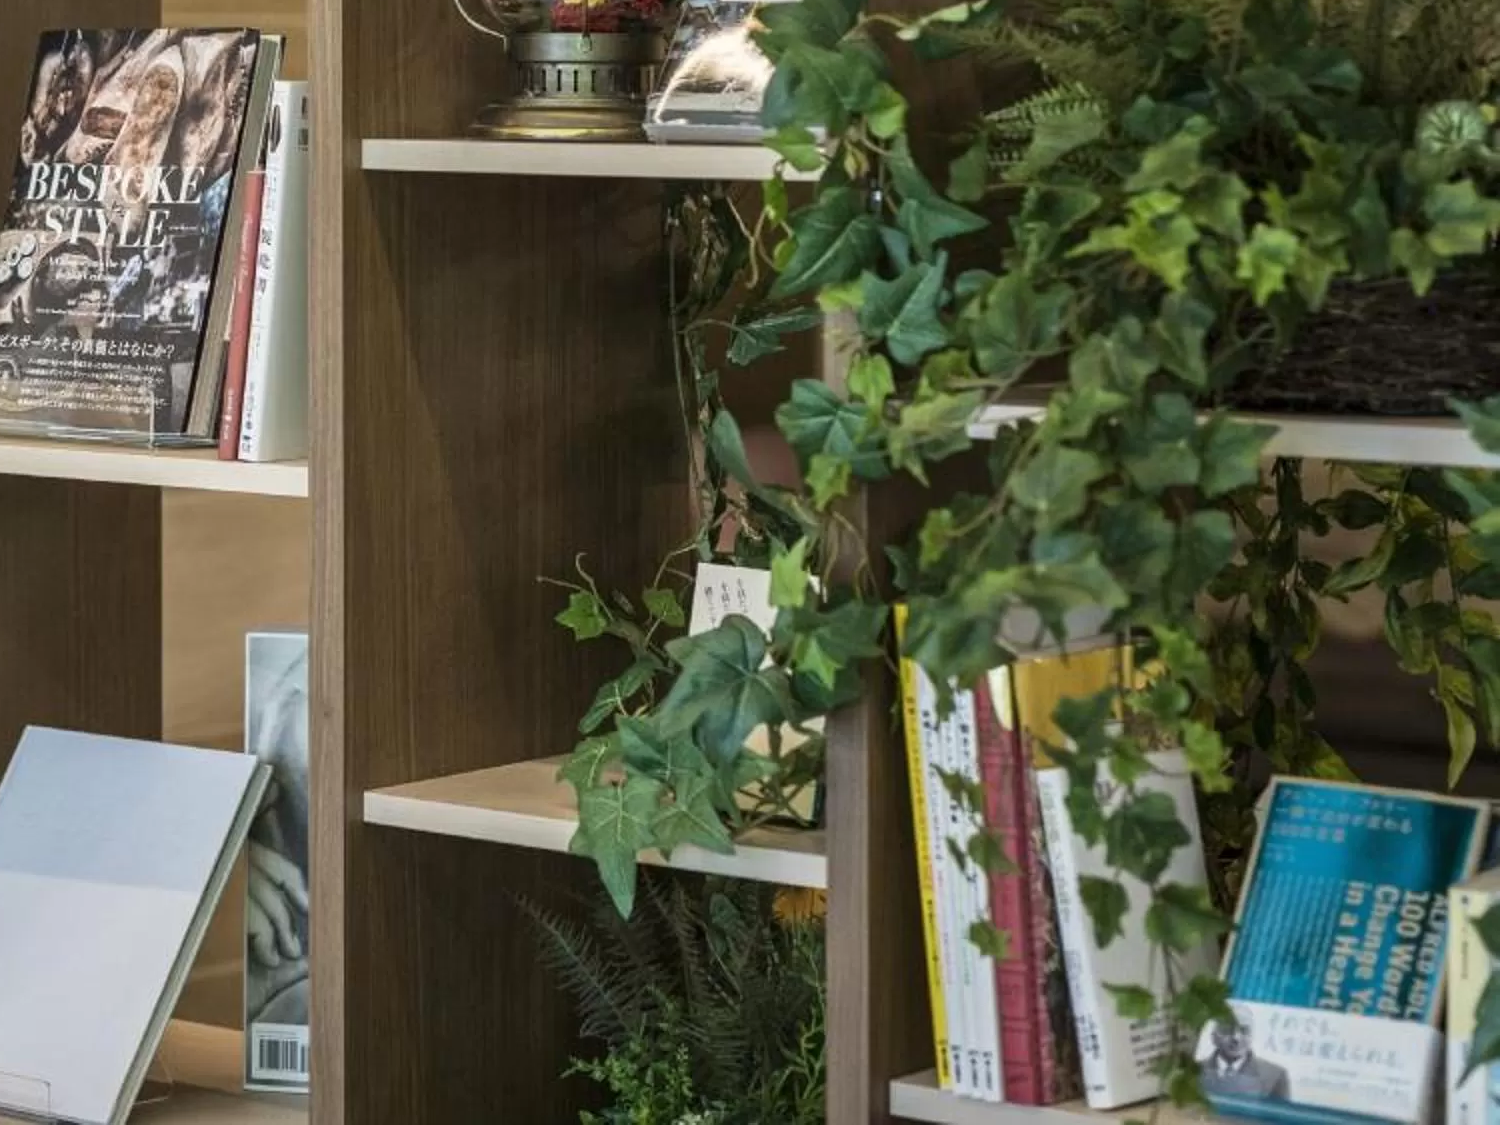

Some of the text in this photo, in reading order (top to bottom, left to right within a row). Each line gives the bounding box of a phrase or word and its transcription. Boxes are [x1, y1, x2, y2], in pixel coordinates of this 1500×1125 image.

[26, 161, 206, 204] BESPOKE
[45, 204, 170, 248] STYLE
[1353, 883, 1400, 981] Change
[1376, 890, 1430, 1017] 100 Word
